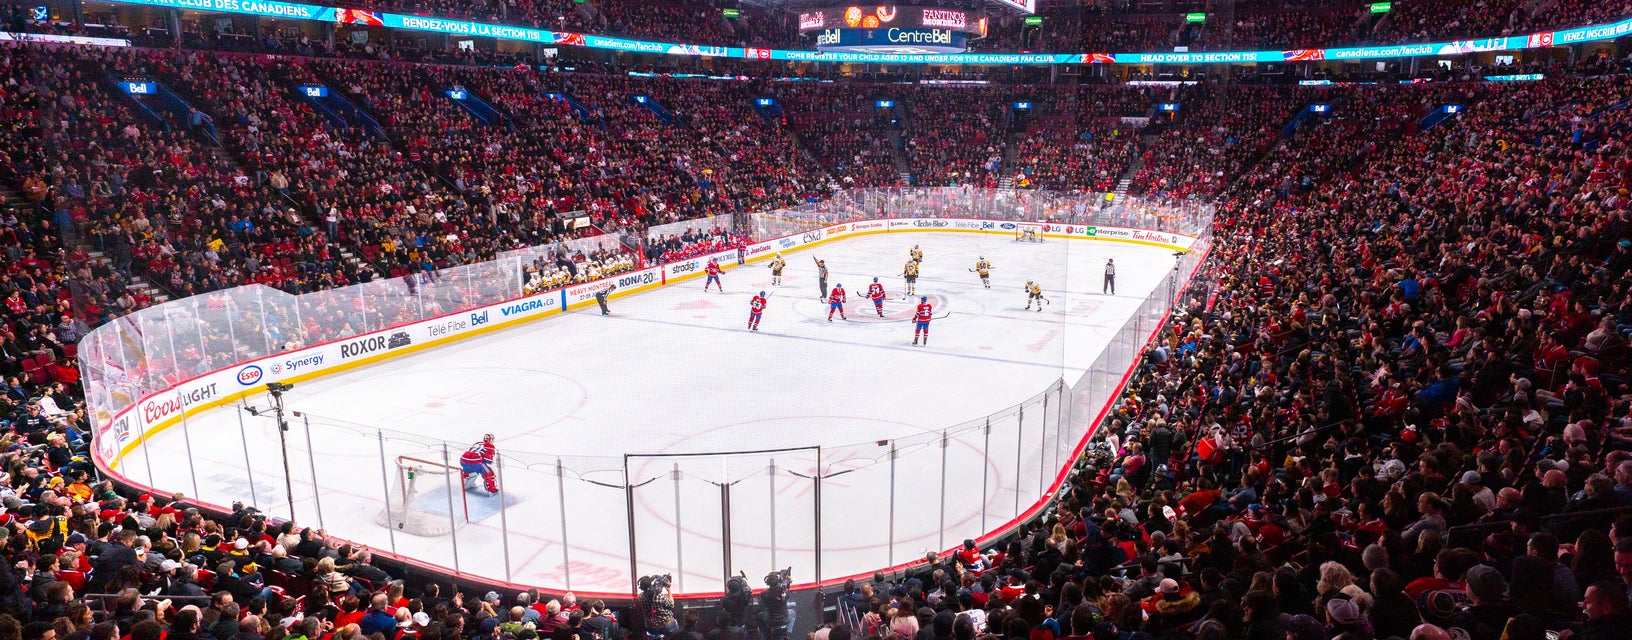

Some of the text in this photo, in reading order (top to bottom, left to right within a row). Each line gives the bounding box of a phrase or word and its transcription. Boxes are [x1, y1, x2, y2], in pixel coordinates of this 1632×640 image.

[215, 0, 239, 10] DES
[242, 2, 311, 17] CANADIENS.
[403, 17, 469, 33] RENDEZ-VOUS
[471, 22, 477, 34] À
[480, 26, 490, 35] LA
[492, 28, 526, 38] SECTION
[887, 27, 952, 44] CentreBell
[594, 38, 663, 51] canadiens.com/fanclub
[1563, 31, 1586, 42] VENEZ
[1336, 45, 1433, 57] canadiens.com/fanclub
[130, 83, 147, 93] Bell
[307, 87, 320, 97] Bell
[982, 221, 995, 229] Bell
[1132, 230, 1145, 239] Tim
[619, 274, 643, 288] RONA
[643, 272, 654, 284] 20
[501, 297, 554, 317] VIAGRA.ca
[471, 310, 489, 327] Bell
[428, 318, 466, 338] Télé Fibe
[341, 335, 386, 359] ROXOR
[285, 354, 324, 371] Synergy
[241, 370, 260, 381] Esso
[144, 382, 217, 425] Coors LIGHT
